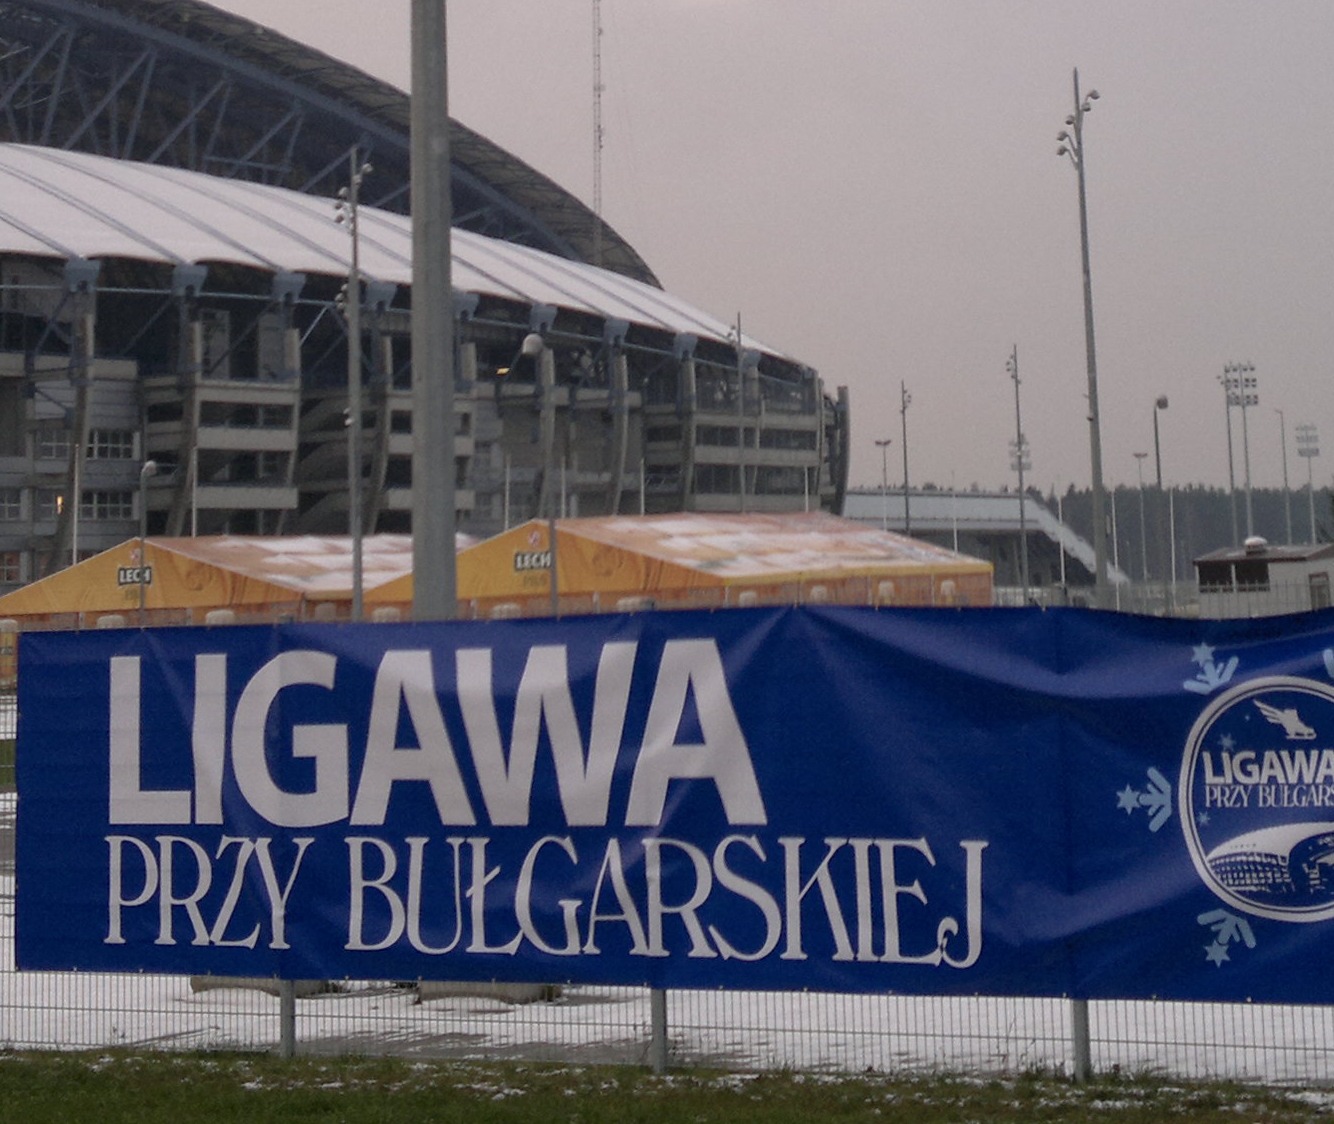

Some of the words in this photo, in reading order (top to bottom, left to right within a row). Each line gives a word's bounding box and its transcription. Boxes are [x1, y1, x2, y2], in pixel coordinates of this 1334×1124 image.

[516, 552, 552, 569] LECH
[108, 638, 768, 828] LIGAWA
[1205, 784, 1252, 808] PRZY
[104, 835, 315, 950] PRZY
[344, 834, 990, 969] BUŁGARSKIEJ
